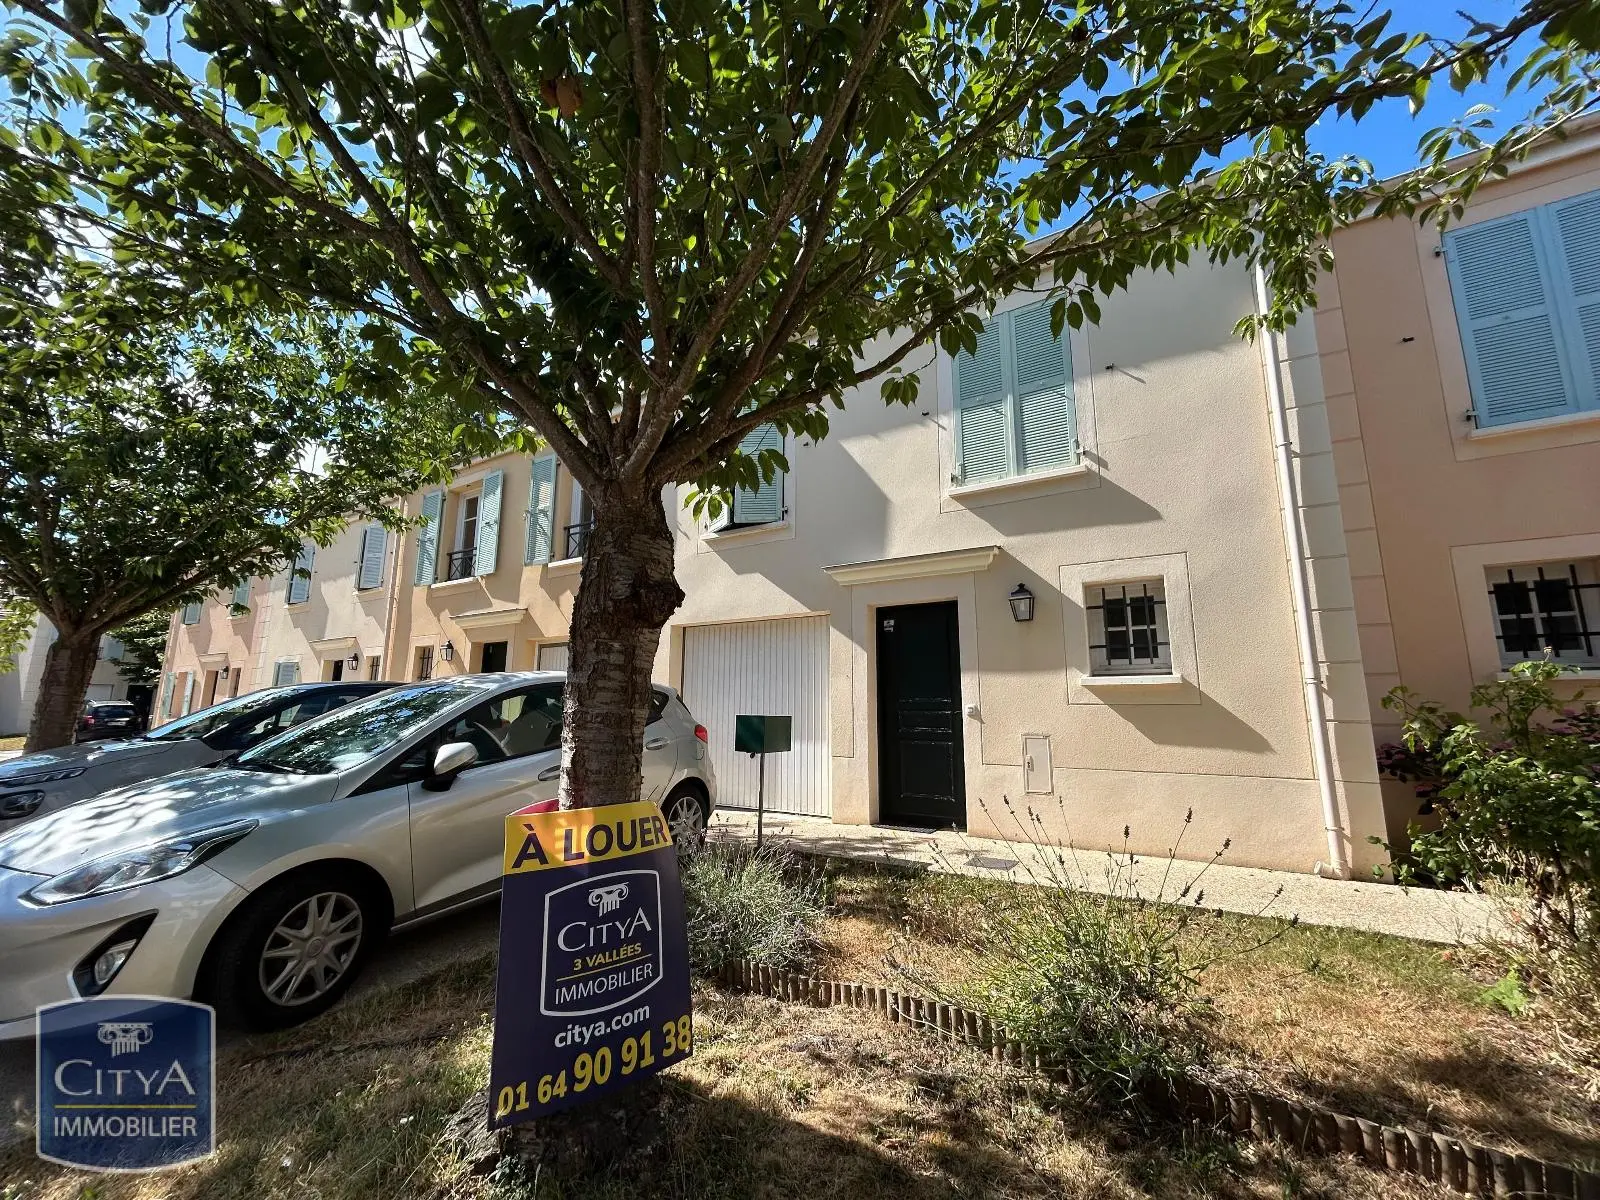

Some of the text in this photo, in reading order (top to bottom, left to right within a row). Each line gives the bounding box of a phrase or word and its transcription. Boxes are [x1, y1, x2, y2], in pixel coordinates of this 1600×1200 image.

[511, 815, 668, 869] À LOUER
[556, 907, 652, 951] CITYA
[573, 942, 642, 971] 3 VALLÉES
[555, 963, 653, 1005] IMMOBILIER
[554, 1005, 650, 1048] citya.com
[497, 1014, 692, 1117] 01 64 90 91 38
